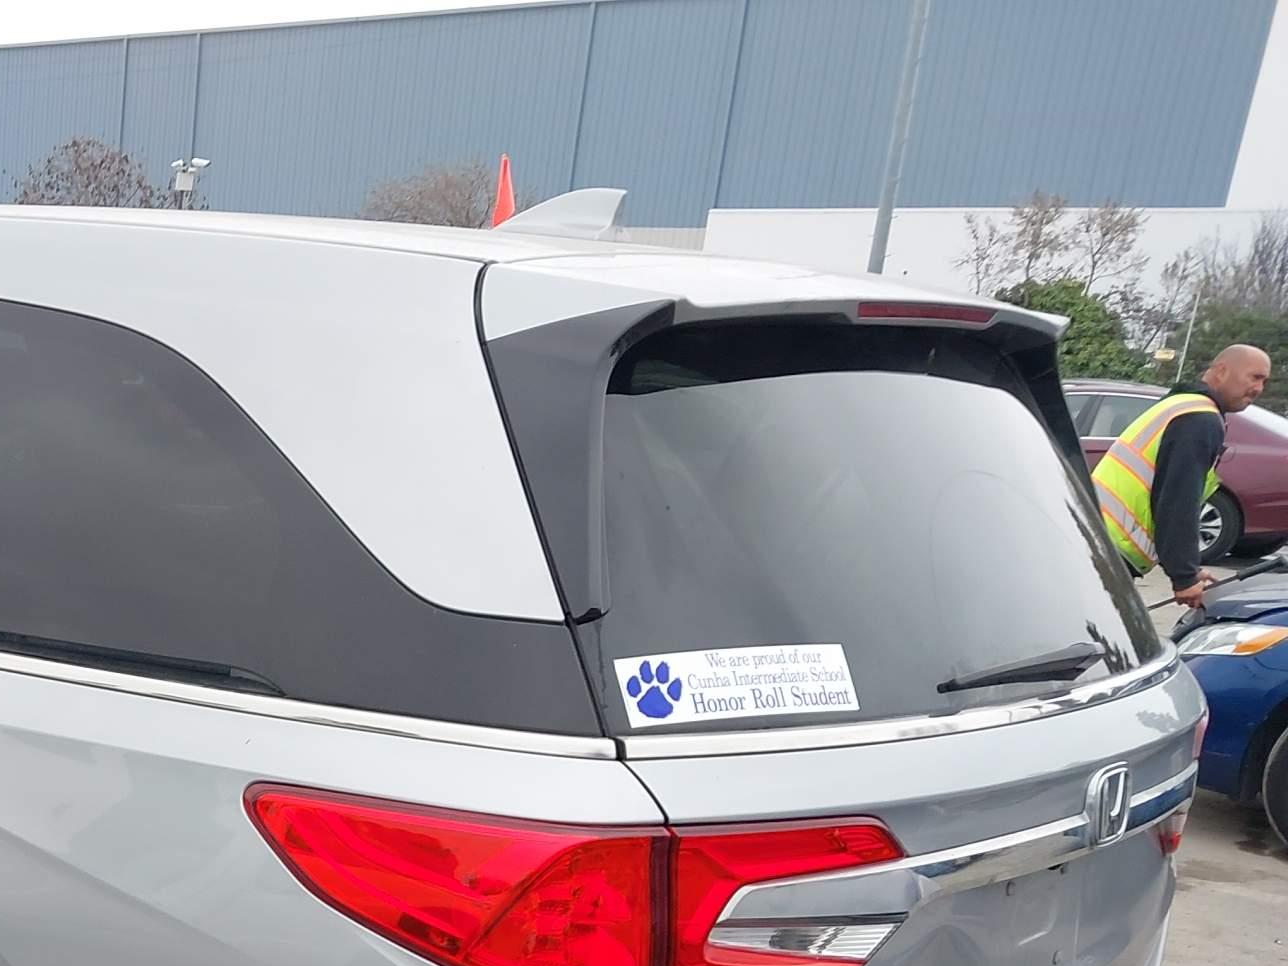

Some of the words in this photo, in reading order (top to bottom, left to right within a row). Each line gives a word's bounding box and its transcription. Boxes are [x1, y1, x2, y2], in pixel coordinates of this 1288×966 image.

[705, 652, 727, 669] We
[729, 656, 749, 667] are
[752, 650, 786, 669] proud
[789, 648, 800, 663] of
[801, 649, 822, 662] our
[688, 671, 730, 690] Cunha
[734, 667, 809, 686] Intermediate
[811, 666, 846, 682] School
[690, 693, 746, 714] Honor
[751, 688, 787, 709] Roll
[792, 685, 852, 707] Student
